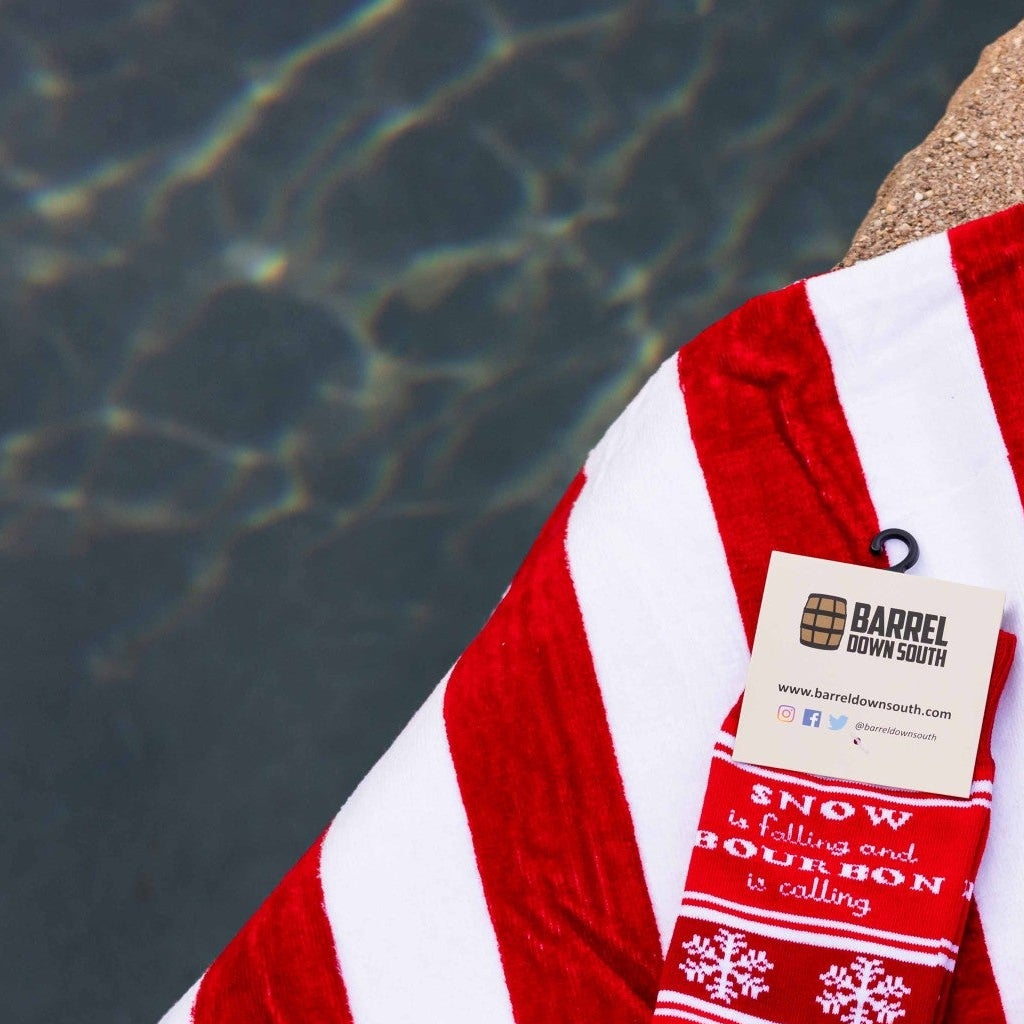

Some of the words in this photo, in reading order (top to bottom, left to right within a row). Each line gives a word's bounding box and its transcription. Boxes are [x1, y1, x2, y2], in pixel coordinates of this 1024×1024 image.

[850, 601, 949, 646] BARREL
[846, 634, 893, 659] DOWN
[896, 642, 948, 668] SOUTH
[778, 682, 952, 720] www.barreldownsouth.com
[855, 721, 937, 742] @barreldownsouth
[750, 783, 914, 830] SNOW
[728, 809, 749, 830] is
[758, 812, 851, 856] falling
[859, 842, 919, 864] and
[694, 829, 946, 895] BOURBON
[746, 872, 767, 892] is
[778, 876, 872, 918] calling
